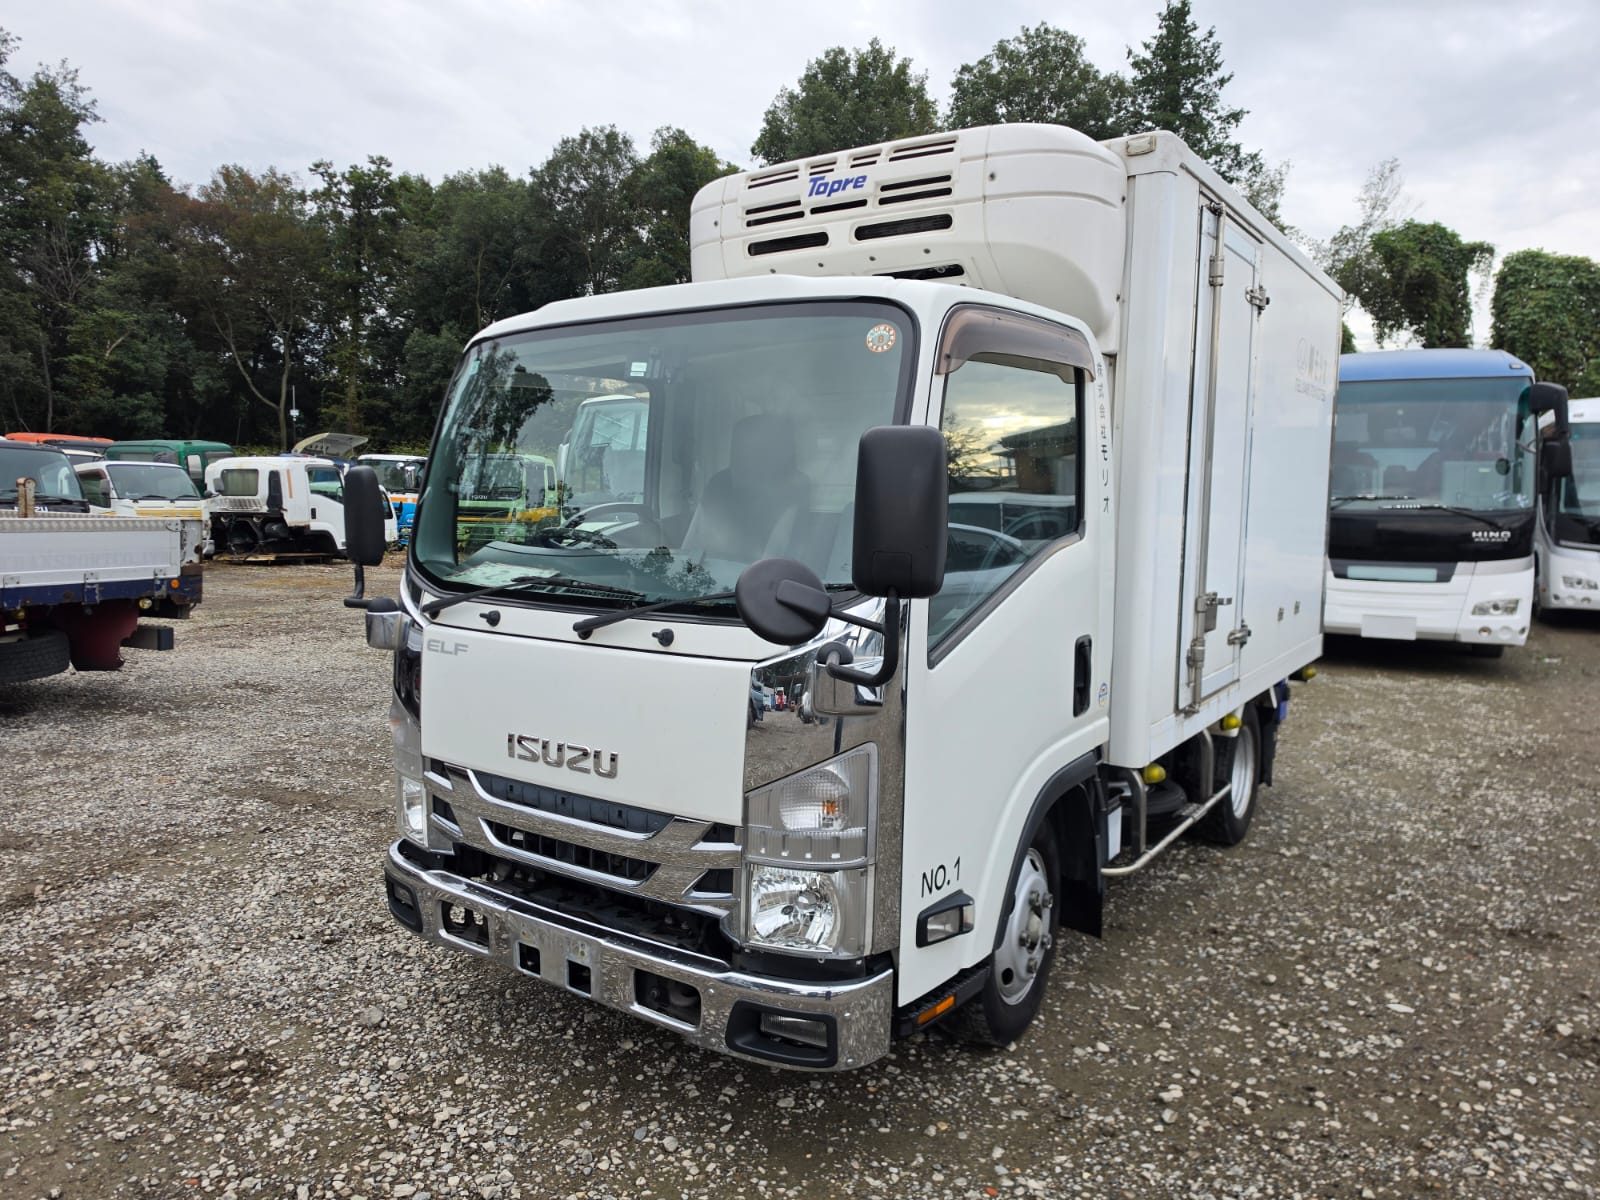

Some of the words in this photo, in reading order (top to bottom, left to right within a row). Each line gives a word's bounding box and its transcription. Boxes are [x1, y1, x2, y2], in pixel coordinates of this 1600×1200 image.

[808, 175, 868, 197] Topre
[427, 639, 469, 656] ELF
[507, 732, 618, 779] ISUZU
